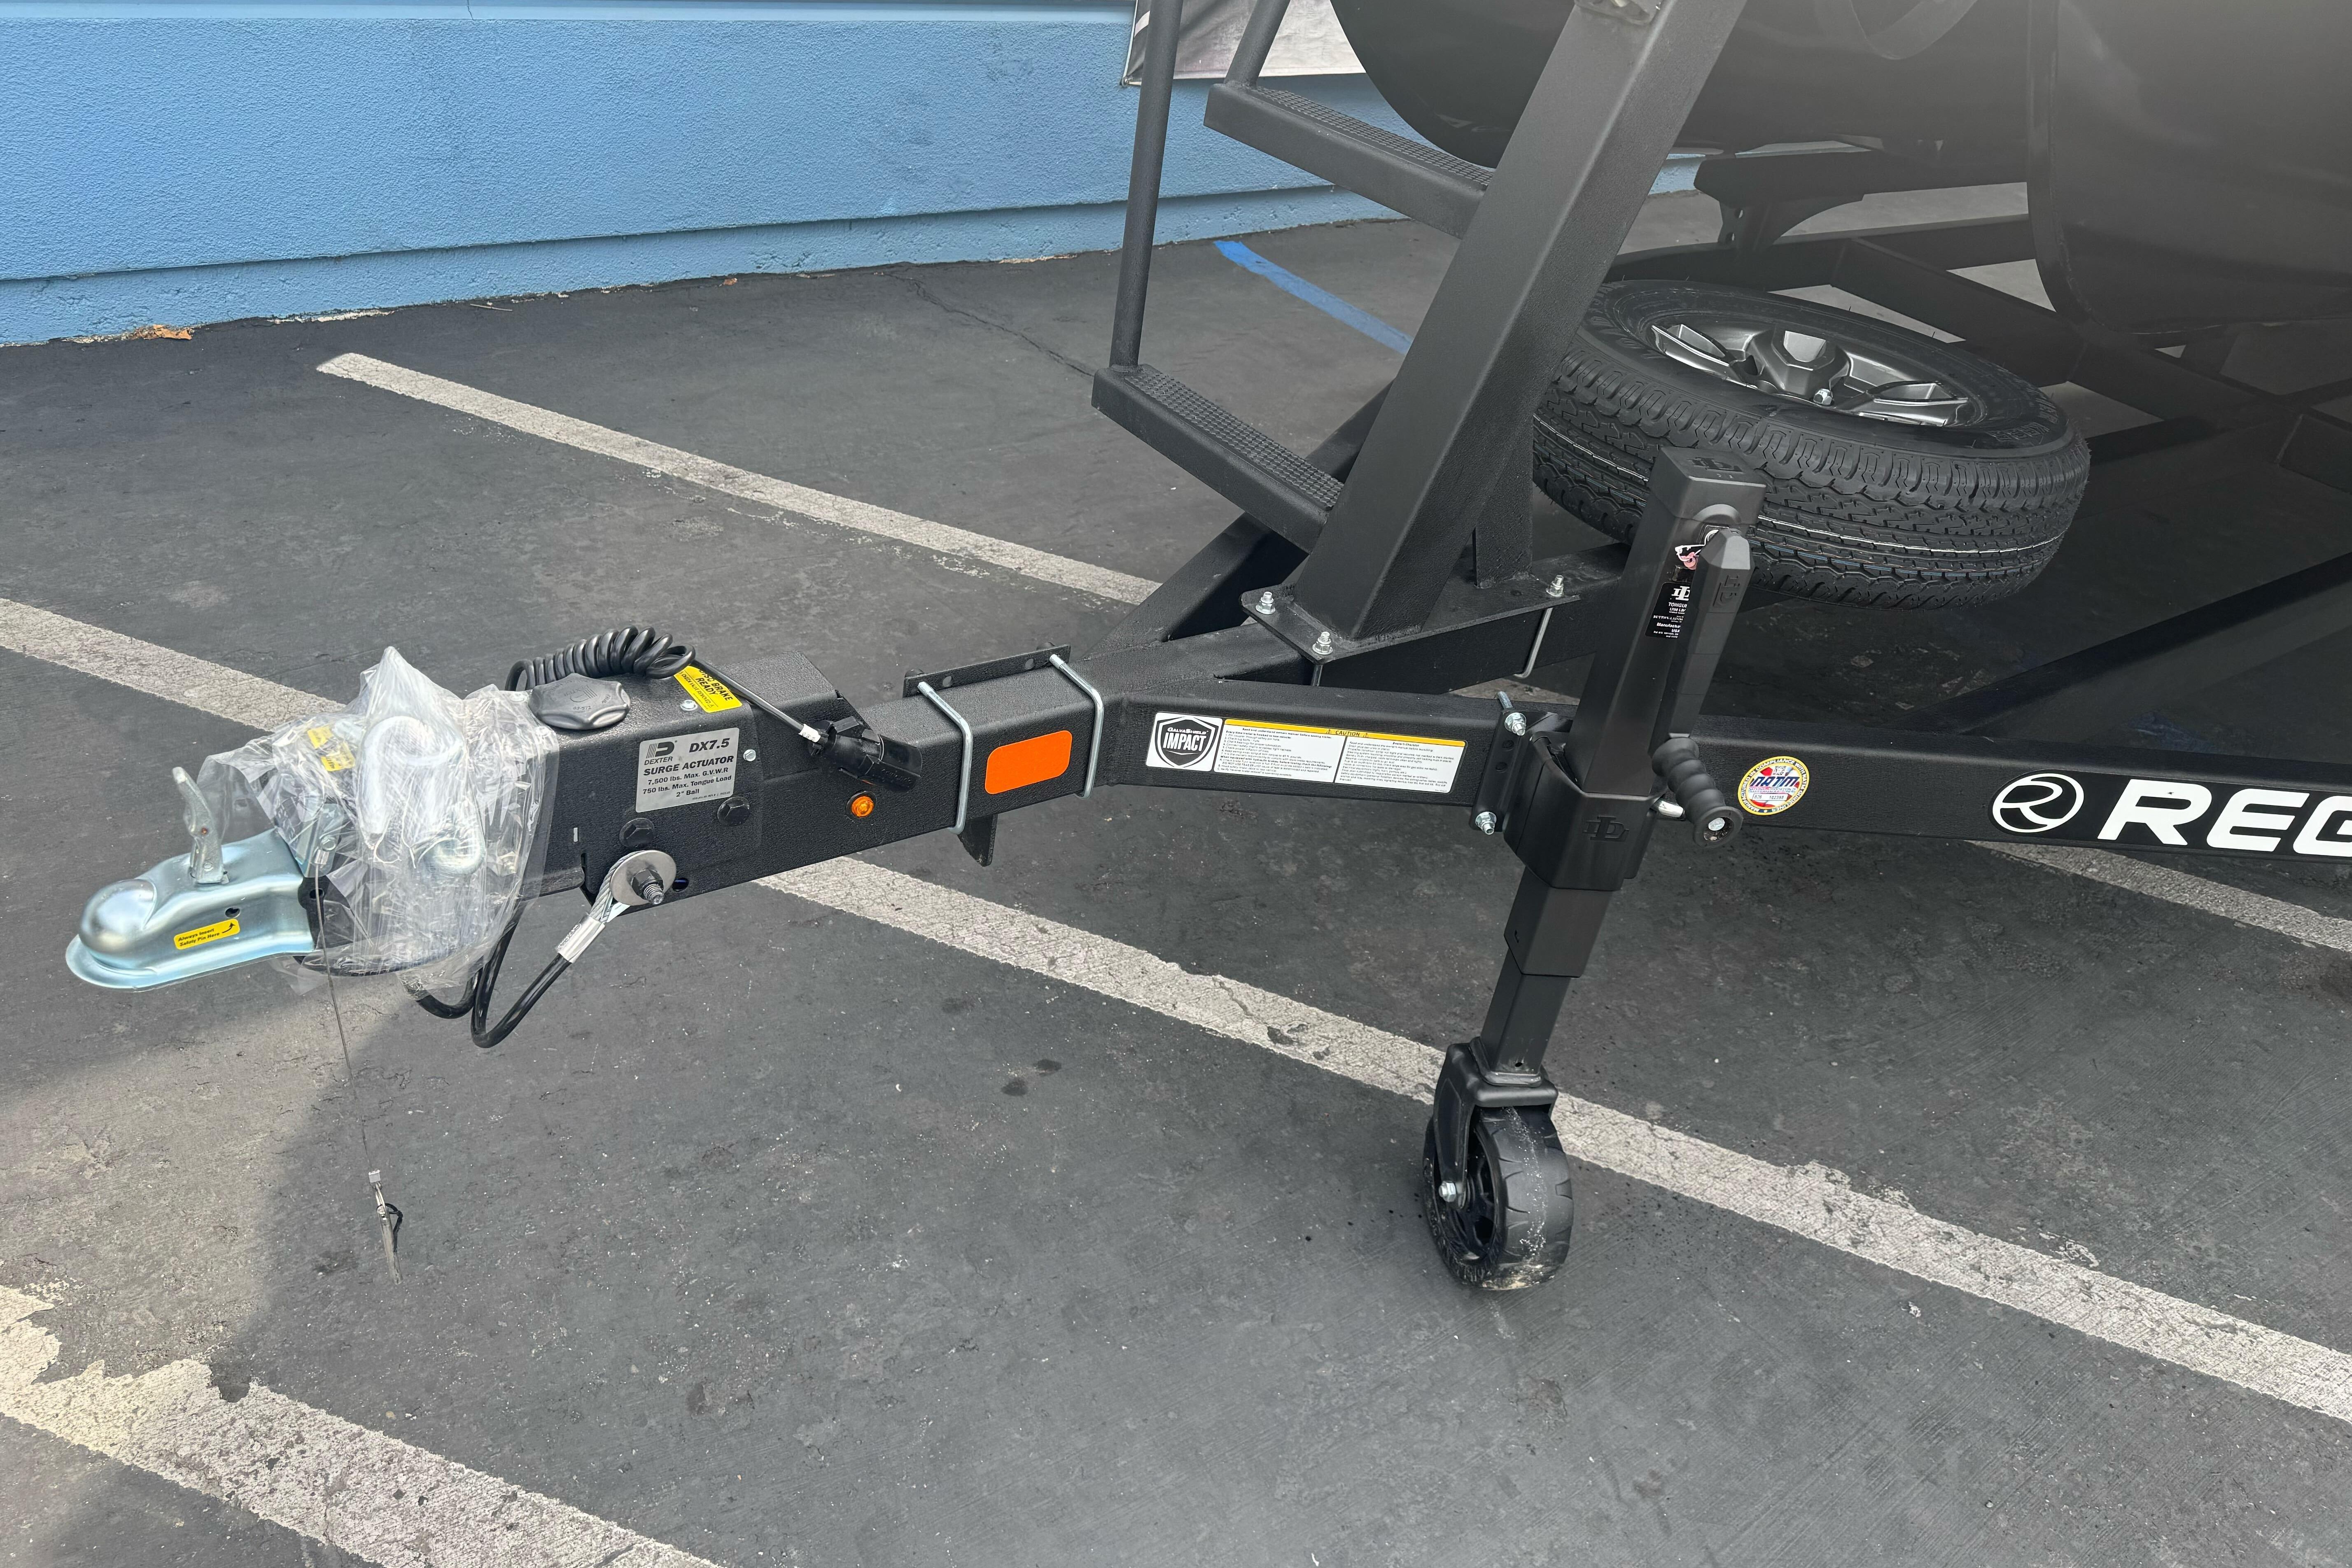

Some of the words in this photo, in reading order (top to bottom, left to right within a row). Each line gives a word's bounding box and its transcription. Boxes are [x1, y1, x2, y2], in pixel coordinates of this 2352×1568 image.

[695, 678, 719, 695] READY
[711, 683, 733, 701] BRAKE
[689, 738, 730, 753] DX7.5
[1163, 732, 1207, 751] IMPACT
[644, 756, 673, 765] DEXTER
[644, 764, 680, 776] SURGE
[682, 756, 734, 770] ACTUATOR
[648, 777, 668, 785] 7,500
[702, 767, 728, 776] G.V.W.R
[1750, 776, 1800, 787] NATM
[178, 933, 198, 942] Always
[180, 938, 196, 947] Safety
